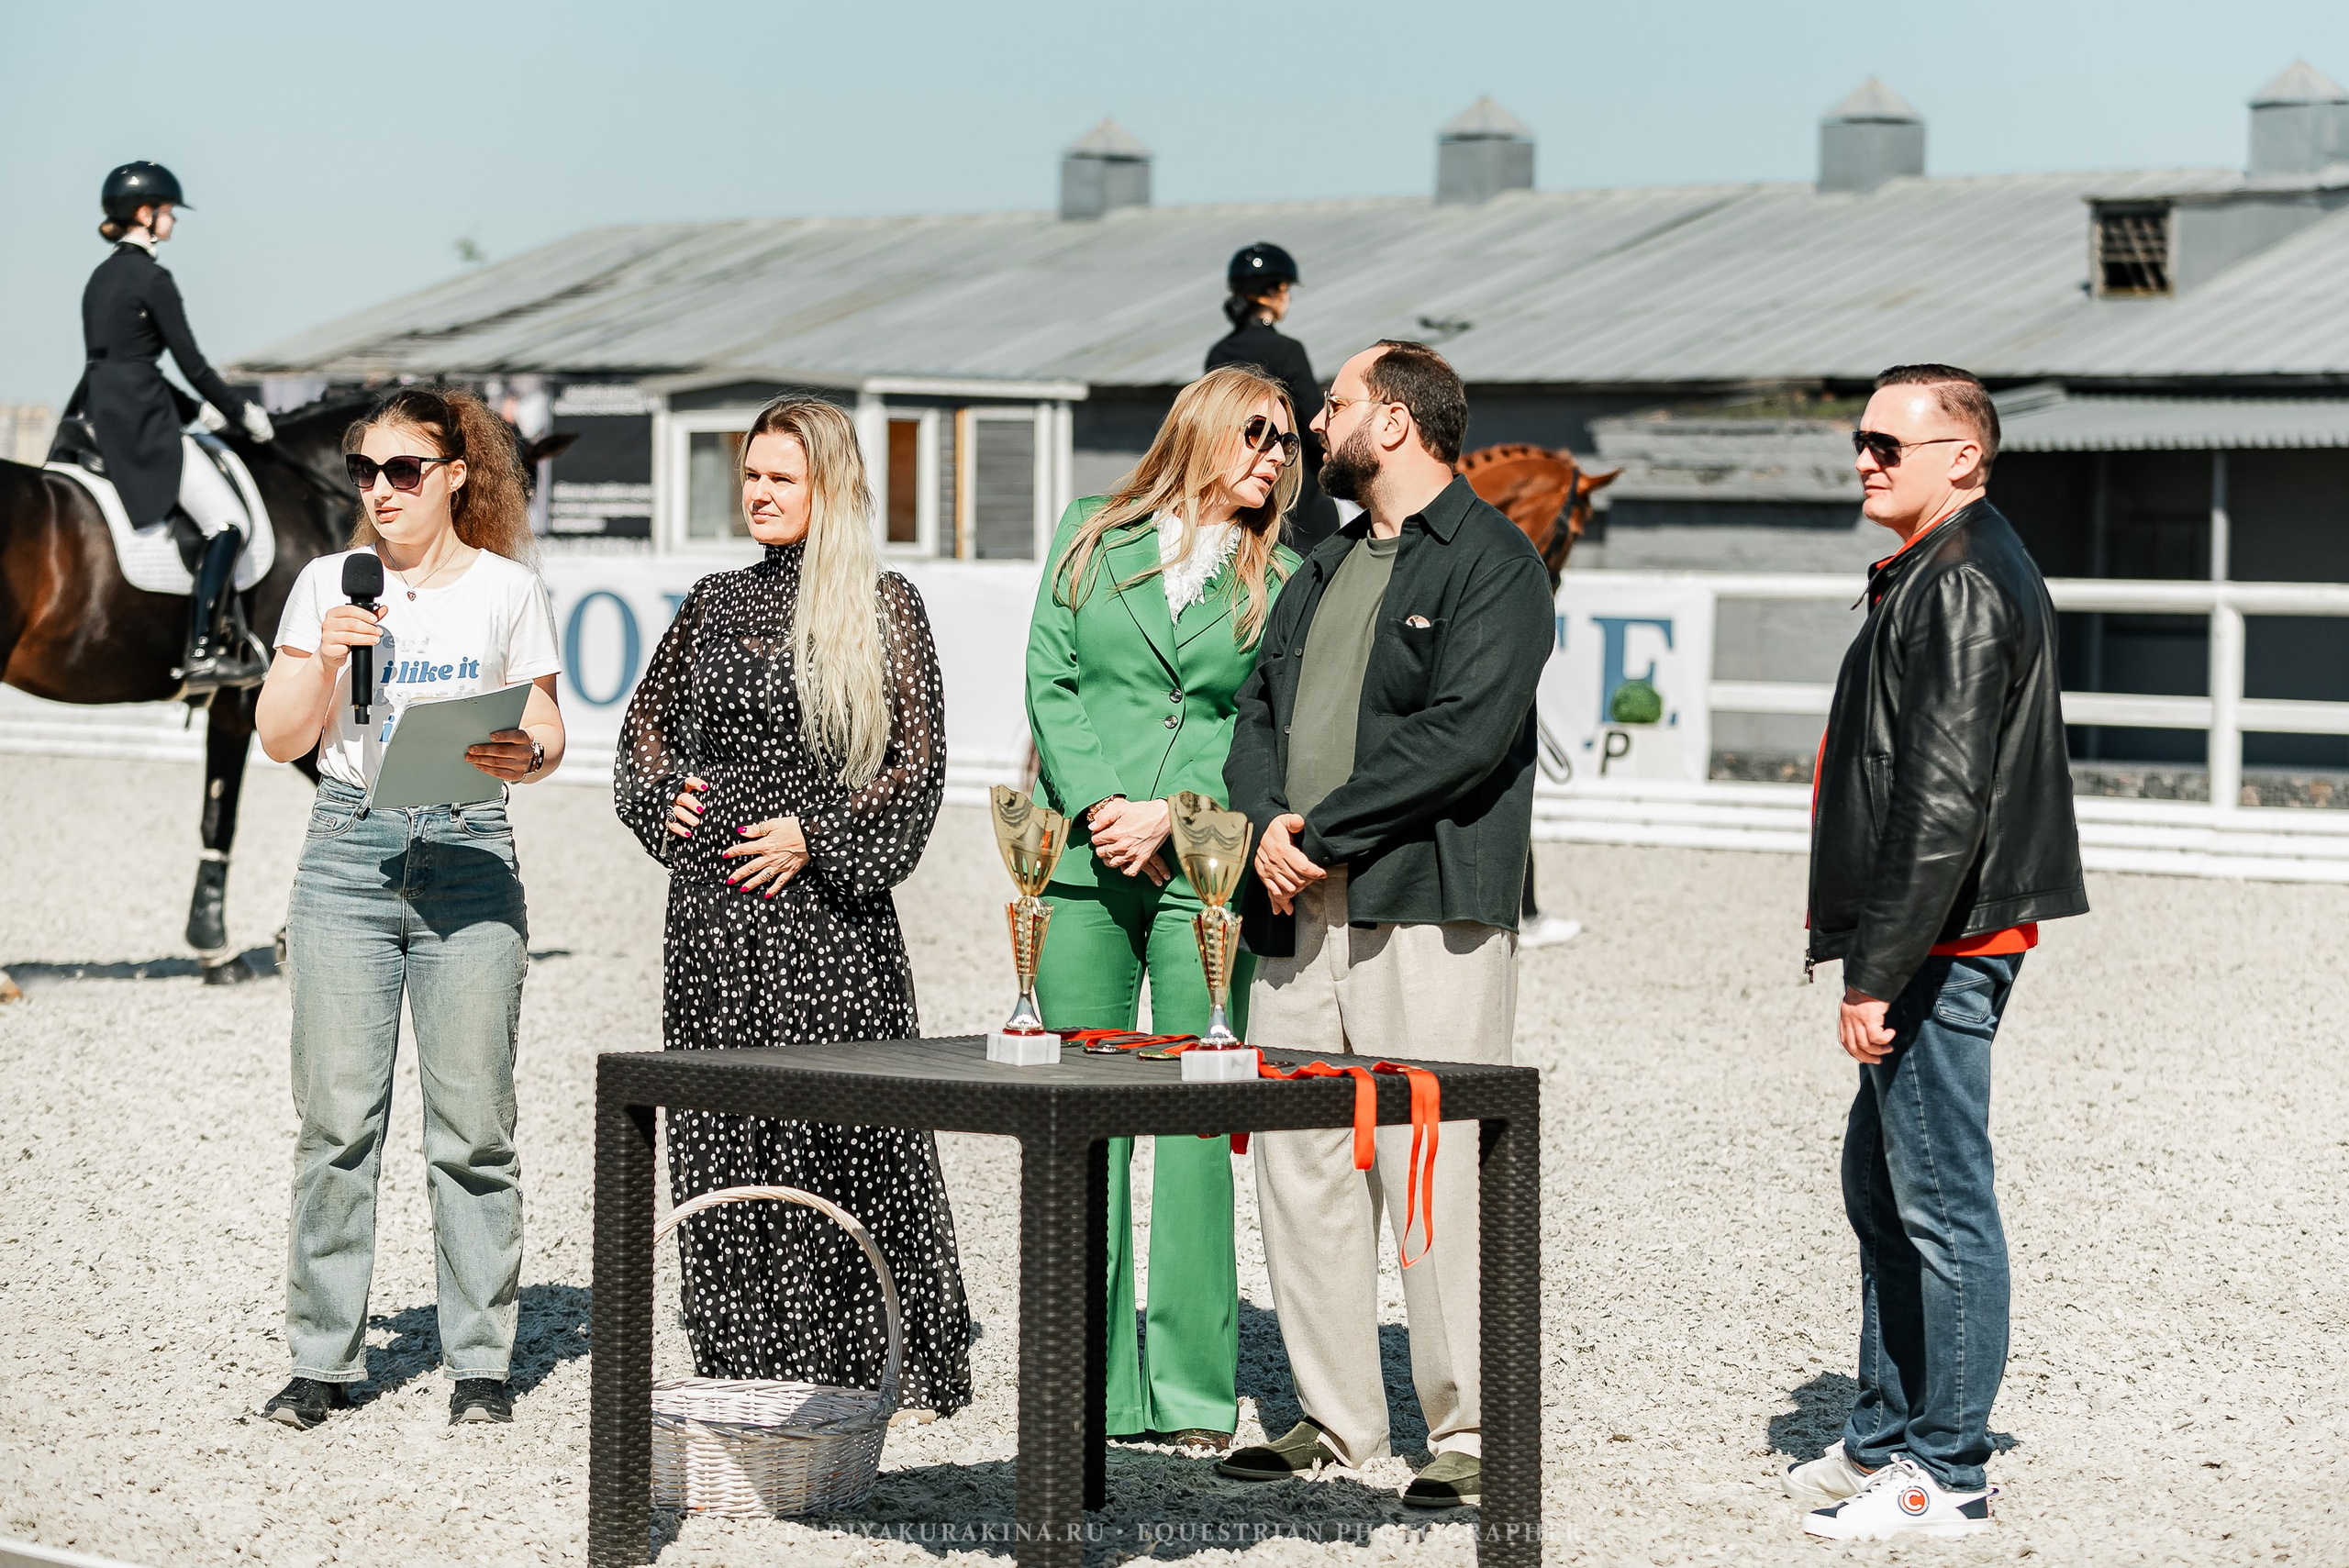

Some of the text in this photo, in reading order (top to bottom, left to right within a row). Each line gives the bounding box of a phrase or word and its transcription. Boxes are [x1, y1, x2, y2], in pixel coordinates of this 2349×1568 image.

[380, 656, 480, 684] i like it
[1556, 616, 1677, 749] E
[1600, 731, 1630, 776] P
